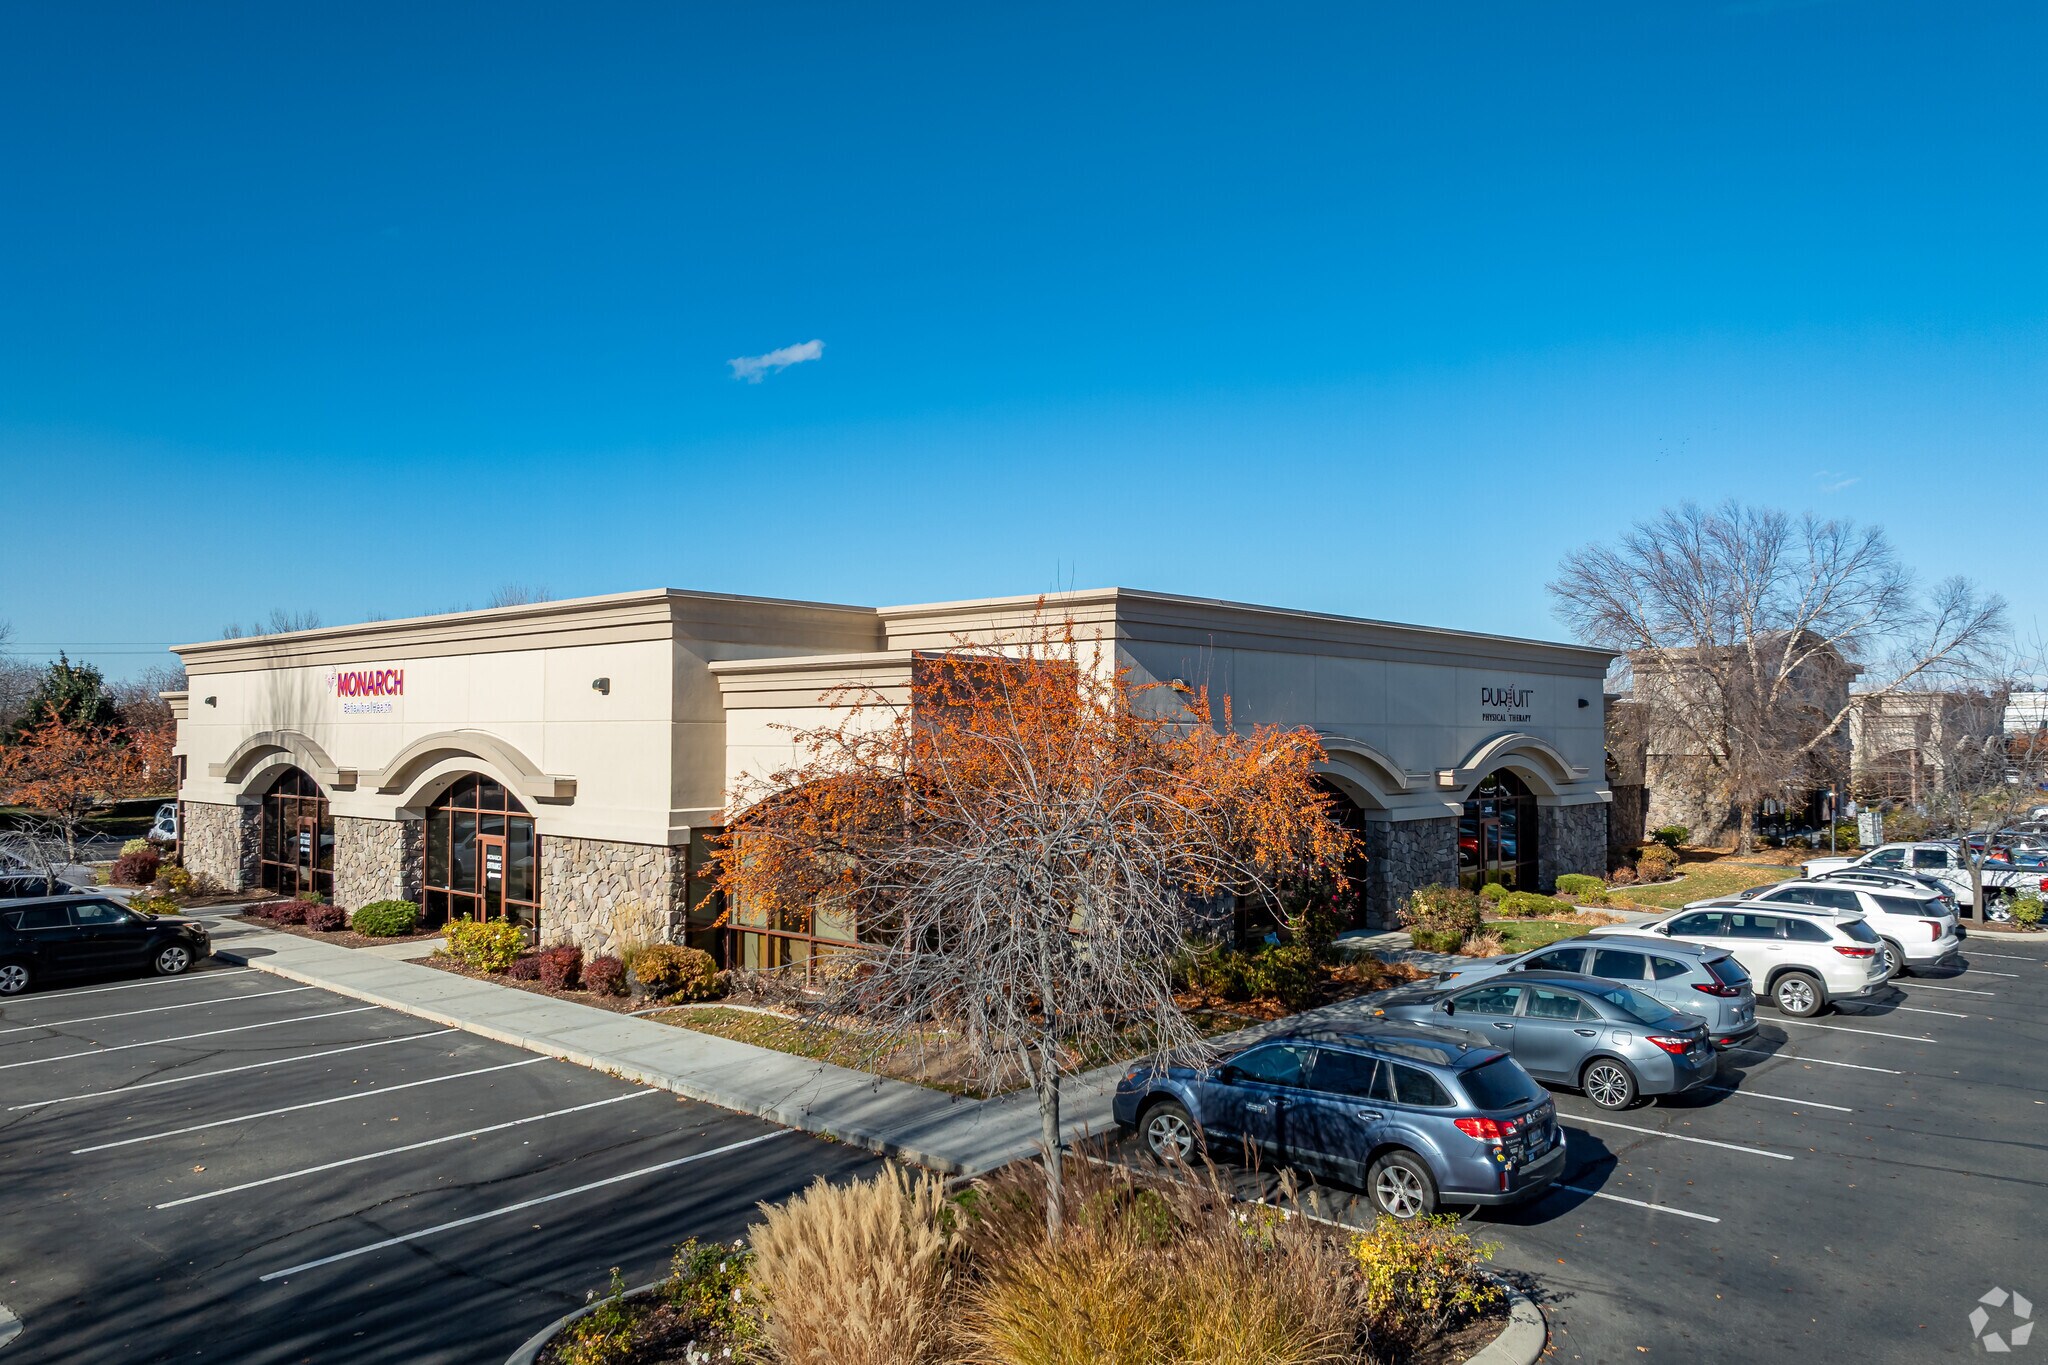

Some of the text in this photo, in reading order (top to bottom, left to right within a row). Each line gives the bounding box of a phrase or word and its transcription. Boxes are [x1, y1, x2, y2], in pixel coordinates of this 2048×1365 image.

[337, 669, 404, 697] MONARCH
[1482, 713, 1531, 722] PHYSICAL THERAPY
